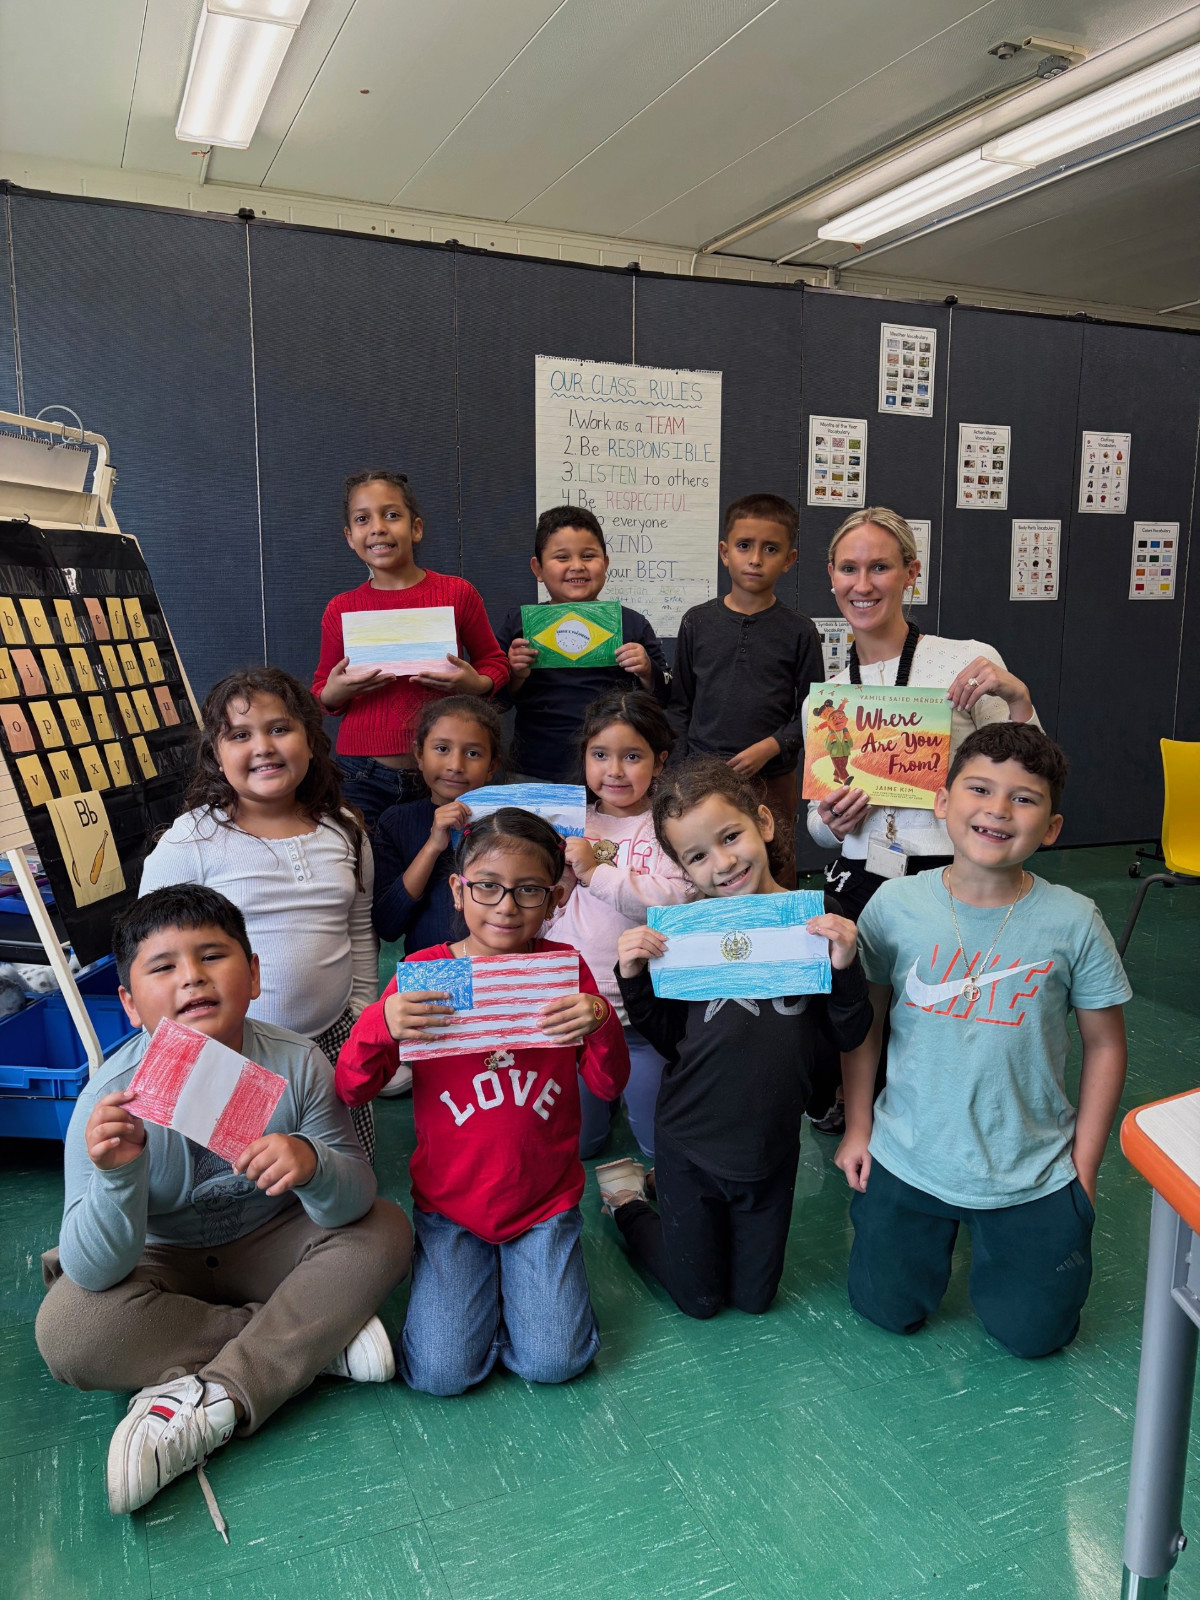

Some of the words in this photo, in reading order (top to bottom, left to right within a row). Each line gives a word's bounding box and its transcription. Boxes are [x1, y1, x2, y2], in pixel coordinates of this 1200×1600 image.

[551, 370, 584, 392] OUR
[592, 375, 637, 397] CLASS
[650, 379, 702, 401] RULES
[616, 420, 629, 432] as
[635, 421, 642, 433] a
[646, 415, 685, 435] TEAM
[608, 438, 716, 463] RESPONSIBLE
[644, 467, 660, 486] to
[668, 468, 709, 488] others
[579, 489, 597, 508] Be
[606, 490, 692, 512] RESPECTFUL
[612, 516, 668, 533] everyone
[605, 534, 652, 554] KIND
[606, 568, 632, 581] your
[637, 560, 679, 579] BEST
[4, 611, 14, 627] b
[34, 616, 42, 628] c
[64, 613, 72, 628] d
[96, 614, 102, 624] e
[114, 611, 120, 624] f
[132, 612, 141, 628] g
[26, 664, 34, 678] i
[53, 664, 60, 681] j
[79, 661, 88, 675] k
[126, 660, 136, 671] m
[148, 657, 156, 668] n
[12, 720, 22, 732] o
[42, 719, 52, 734] p
[70, 718, 81, 730] qu
[98, 714, 104, 724] r
[126, 708, 131, 718] s
[143, 704, 148, 716] t
[163, 702, 170, 711] u
[856, 706, 922, 732] Where
[861, 732, 897, 753] Are
[901, 732, 942, 754] You
[30, 774, 40, 786] v
[59, 768, 70, 781] w
[90, 763, 100, 775] x
[114, 760, 120, 774] y
[142, 752, 148, 764] z
[889, 752, 940, 774] From?
[74, 799, 98, 827] Bb
[440, 1069, 562, 1126] LOVE
